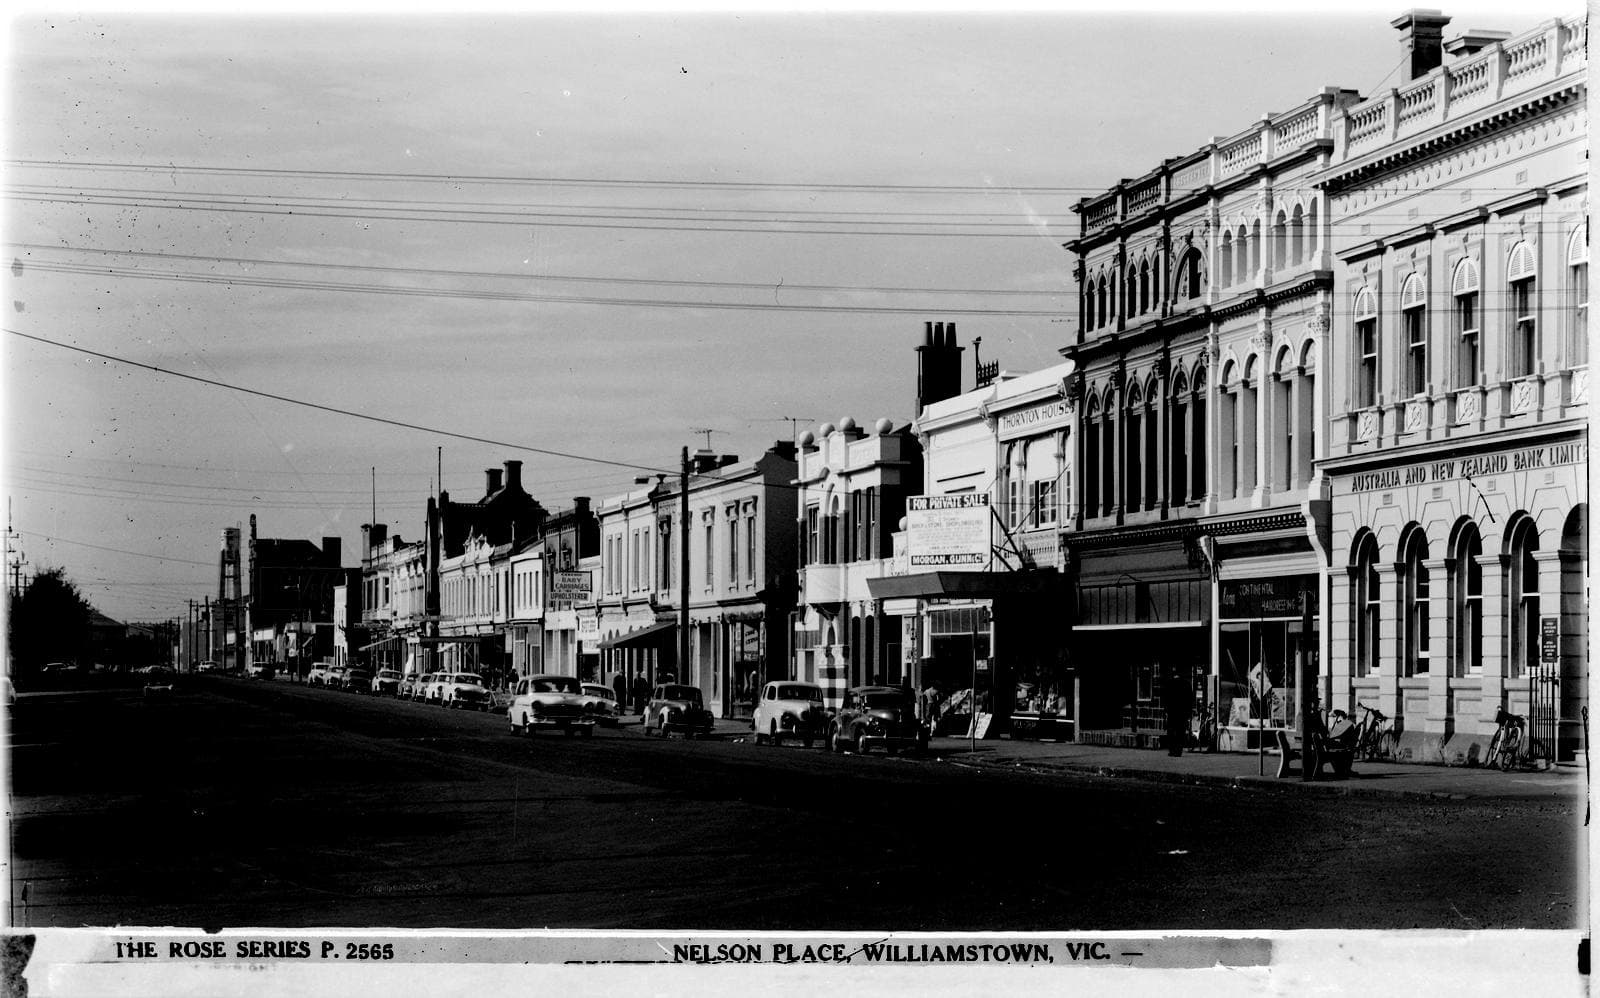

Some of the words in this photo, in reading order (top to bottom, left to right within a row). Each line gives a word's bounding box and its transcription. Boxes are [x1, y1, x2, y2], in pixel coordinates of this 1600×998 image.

[1003, 408, 1040, 431] THORNTON
[1352, 472, 1401, 493] AUSTRALIA
[1405, 468, 1426, 486] AND
[1432, 462, 1456, 481] NEW
[1460, 454, 1508, 478] ZEALAND
[1514, 447, 1545, 469] BANK
[913, 498, 928, 510] FOR
[930, 495, 962, 509] PRIVATE
[963, 493, 985, 507] SALE
